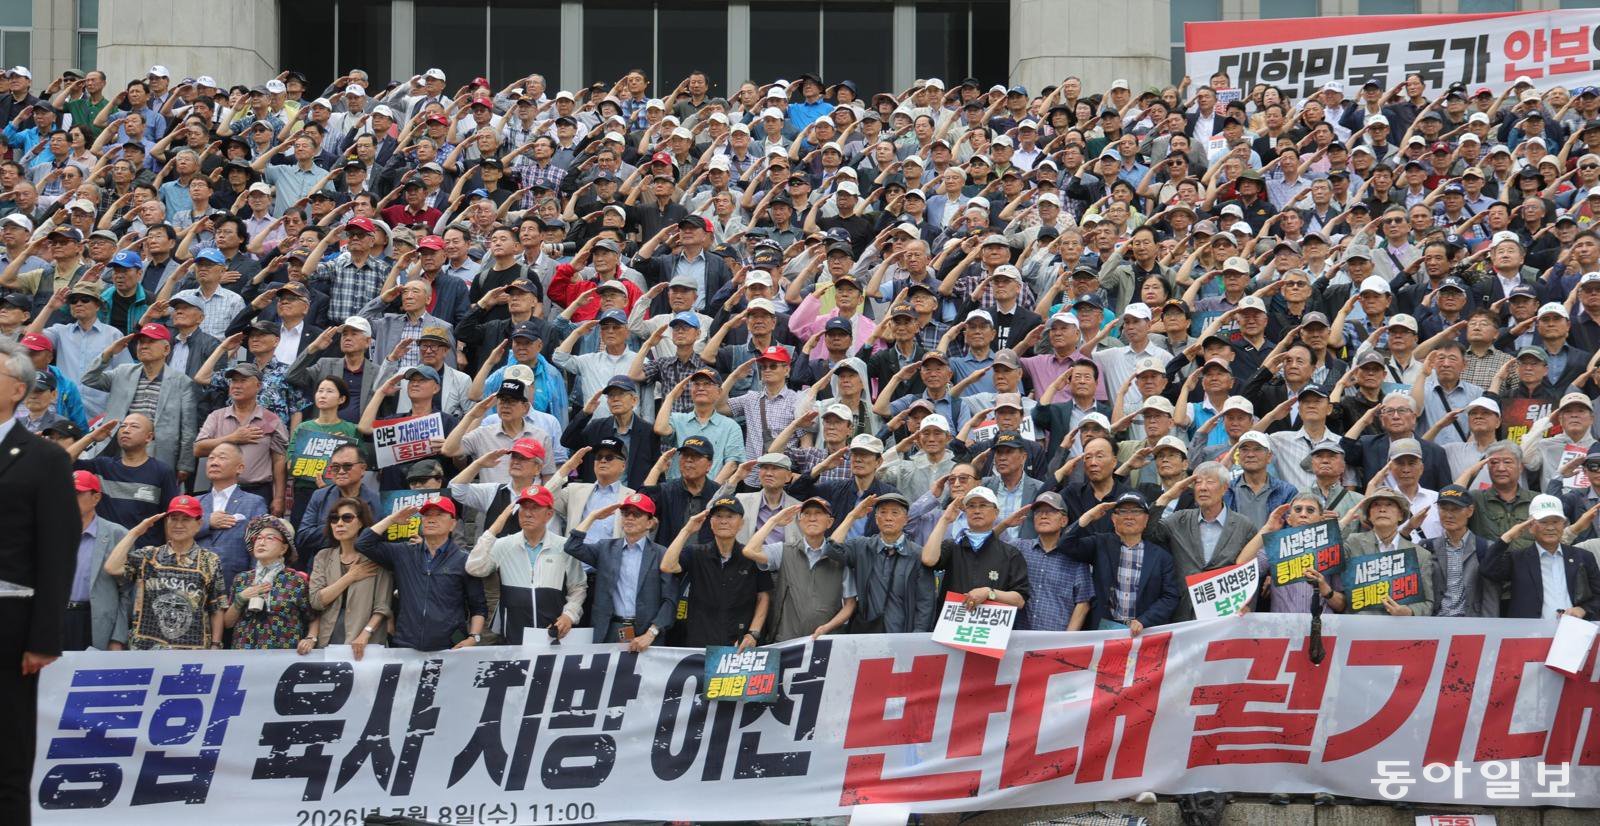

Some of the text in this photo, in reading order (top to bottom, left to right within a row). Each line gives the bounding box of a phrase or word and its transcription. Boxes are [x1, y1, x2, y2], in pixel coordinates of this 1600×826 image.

[1218, 43, 1391, 100] 대한민국
[1405, 34, 1490, 91] 국가
[376, 416, 441, 448] 안보 자해행위
[292, 457, 327, 478] 통폐합
[1279, 523, 1329, 559] 사관학교
[1276, 543, 1341, 584] 통폐합 반대
[1354, 552, 1406, 585] 사관학교
[1193, 562, 1257, 605] 태릉 자연환경
[1351, 572, 1419, 610] 통폐합 반대
[943, 604, 1013, 627] 태릉 안보성지
[953, 625, 991, 645] 보존
[716, 651, 769, 674] 사관학교
[707, 673, 775, 698] 통폐합 반대
[38, 662, 247, 810] 통합
[252, 659, 443, 801] 육사
[447, 651, 641, 792] 지방
[651, 639, 832, 783] 이전
[838, 631, 1172, 807] 반대
[438, 802, 518, 825] 8일(수)
[529, 802, 595, 822] 11:00
